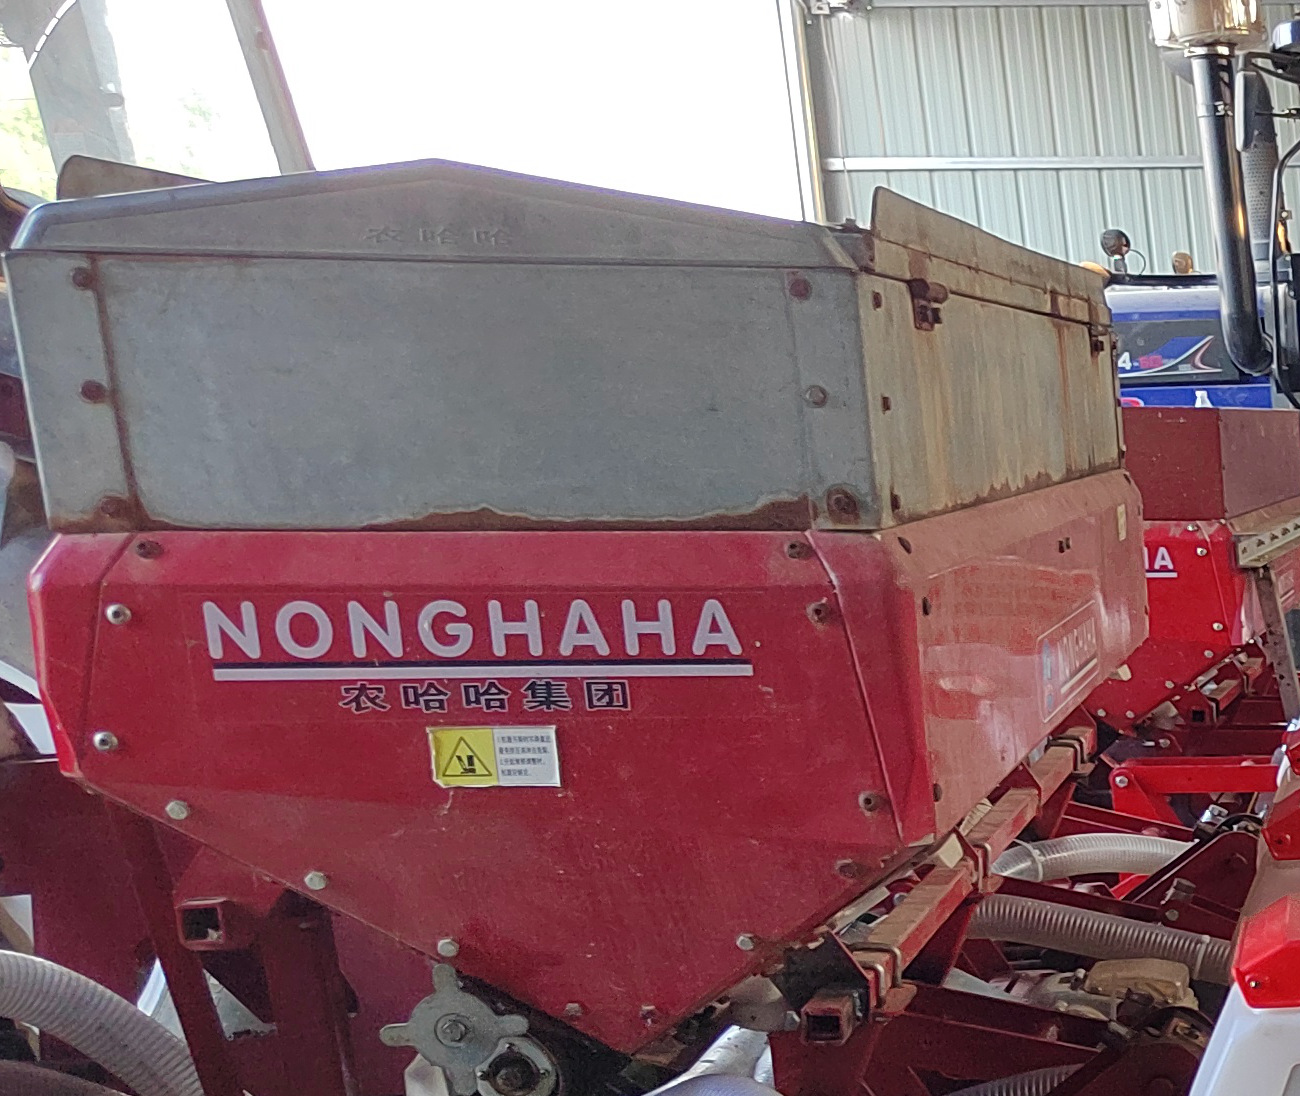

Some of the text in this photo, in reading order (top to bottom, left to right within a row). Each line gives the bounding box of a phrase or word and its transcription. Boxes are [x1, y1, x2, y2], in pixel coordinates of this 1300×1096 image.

[1143, 546, 1174, 570] A
[202, 600, 743, 659] NONGHAHA
[337, 680, 631, 712] 农哈哈集团
